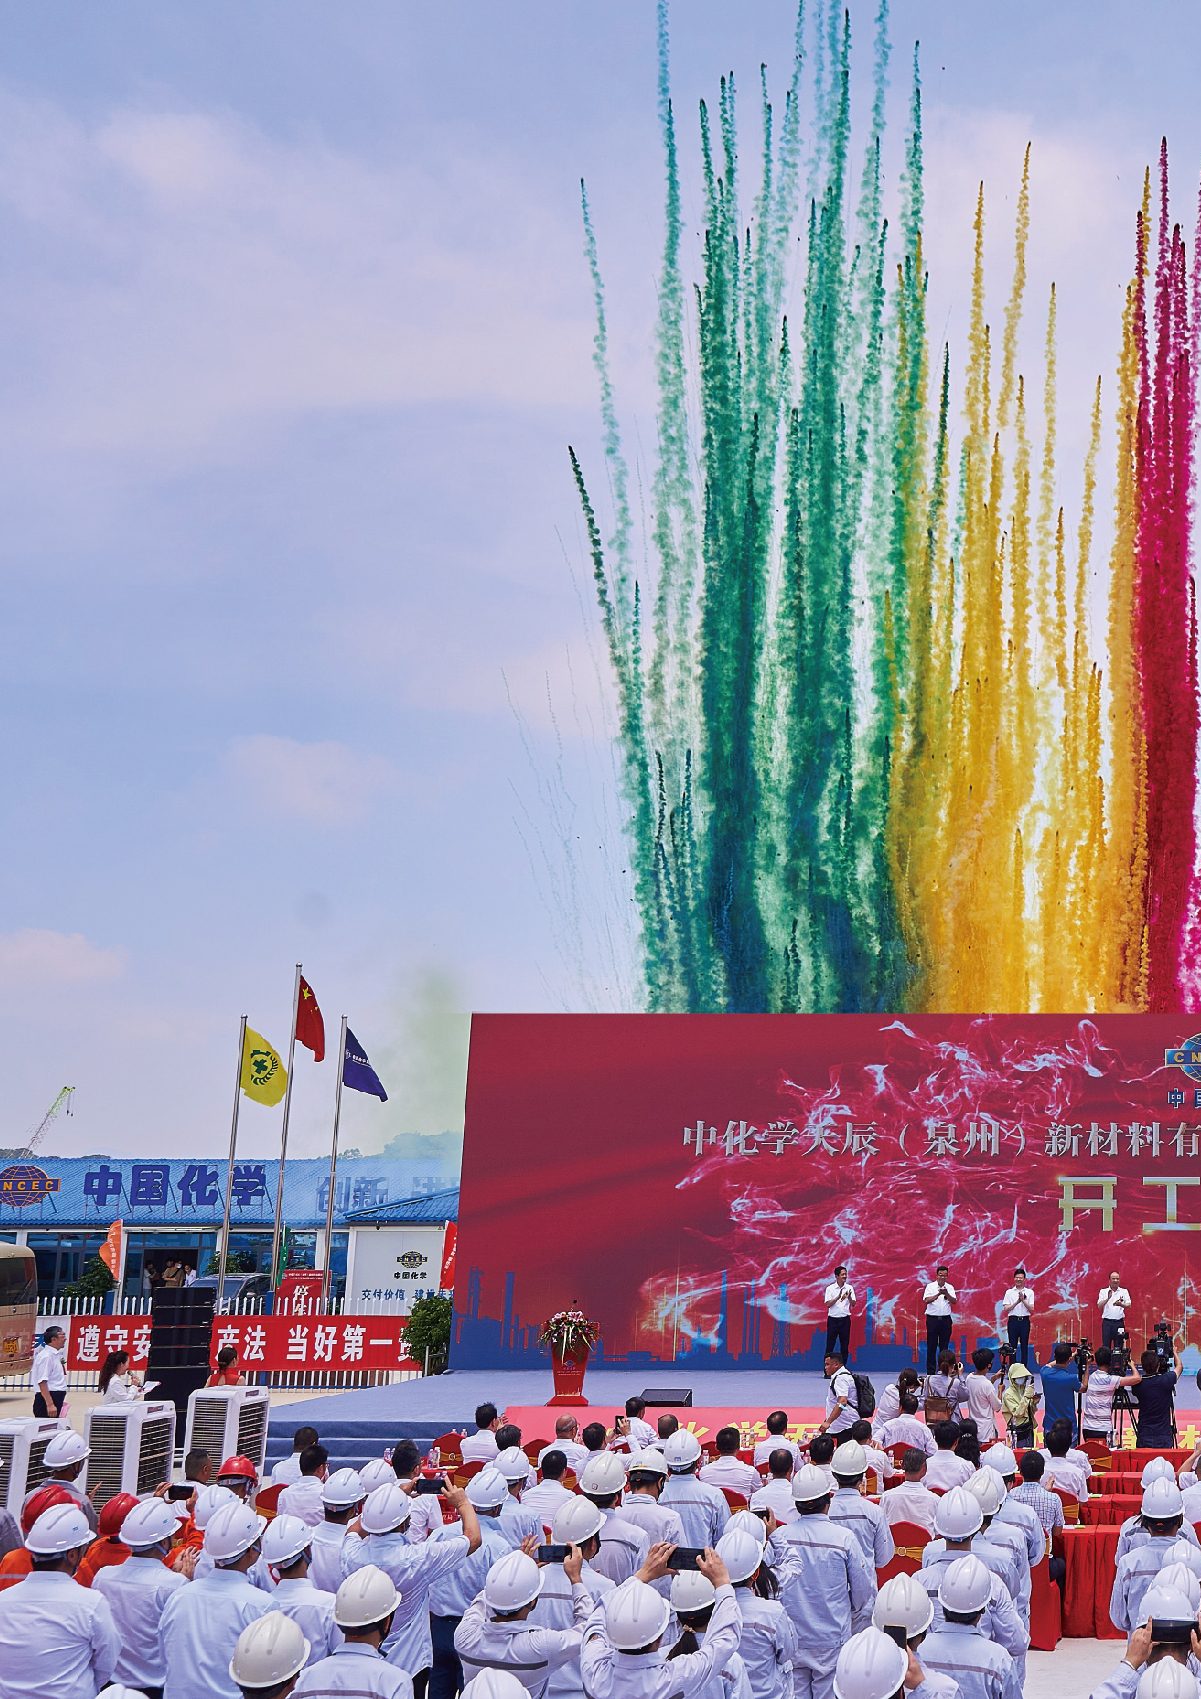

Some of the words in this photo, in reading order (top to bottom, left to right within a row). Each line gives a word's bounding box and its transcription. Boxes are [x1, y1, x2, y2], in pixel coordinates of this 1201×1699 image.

[84, 1164, 267, 1206] 中国化学
[316, 1176, 389, 1213] 创新
[394, 1271, 427, 1280] 中国化学
[361, 1288, 405, 1301] 交付价值
